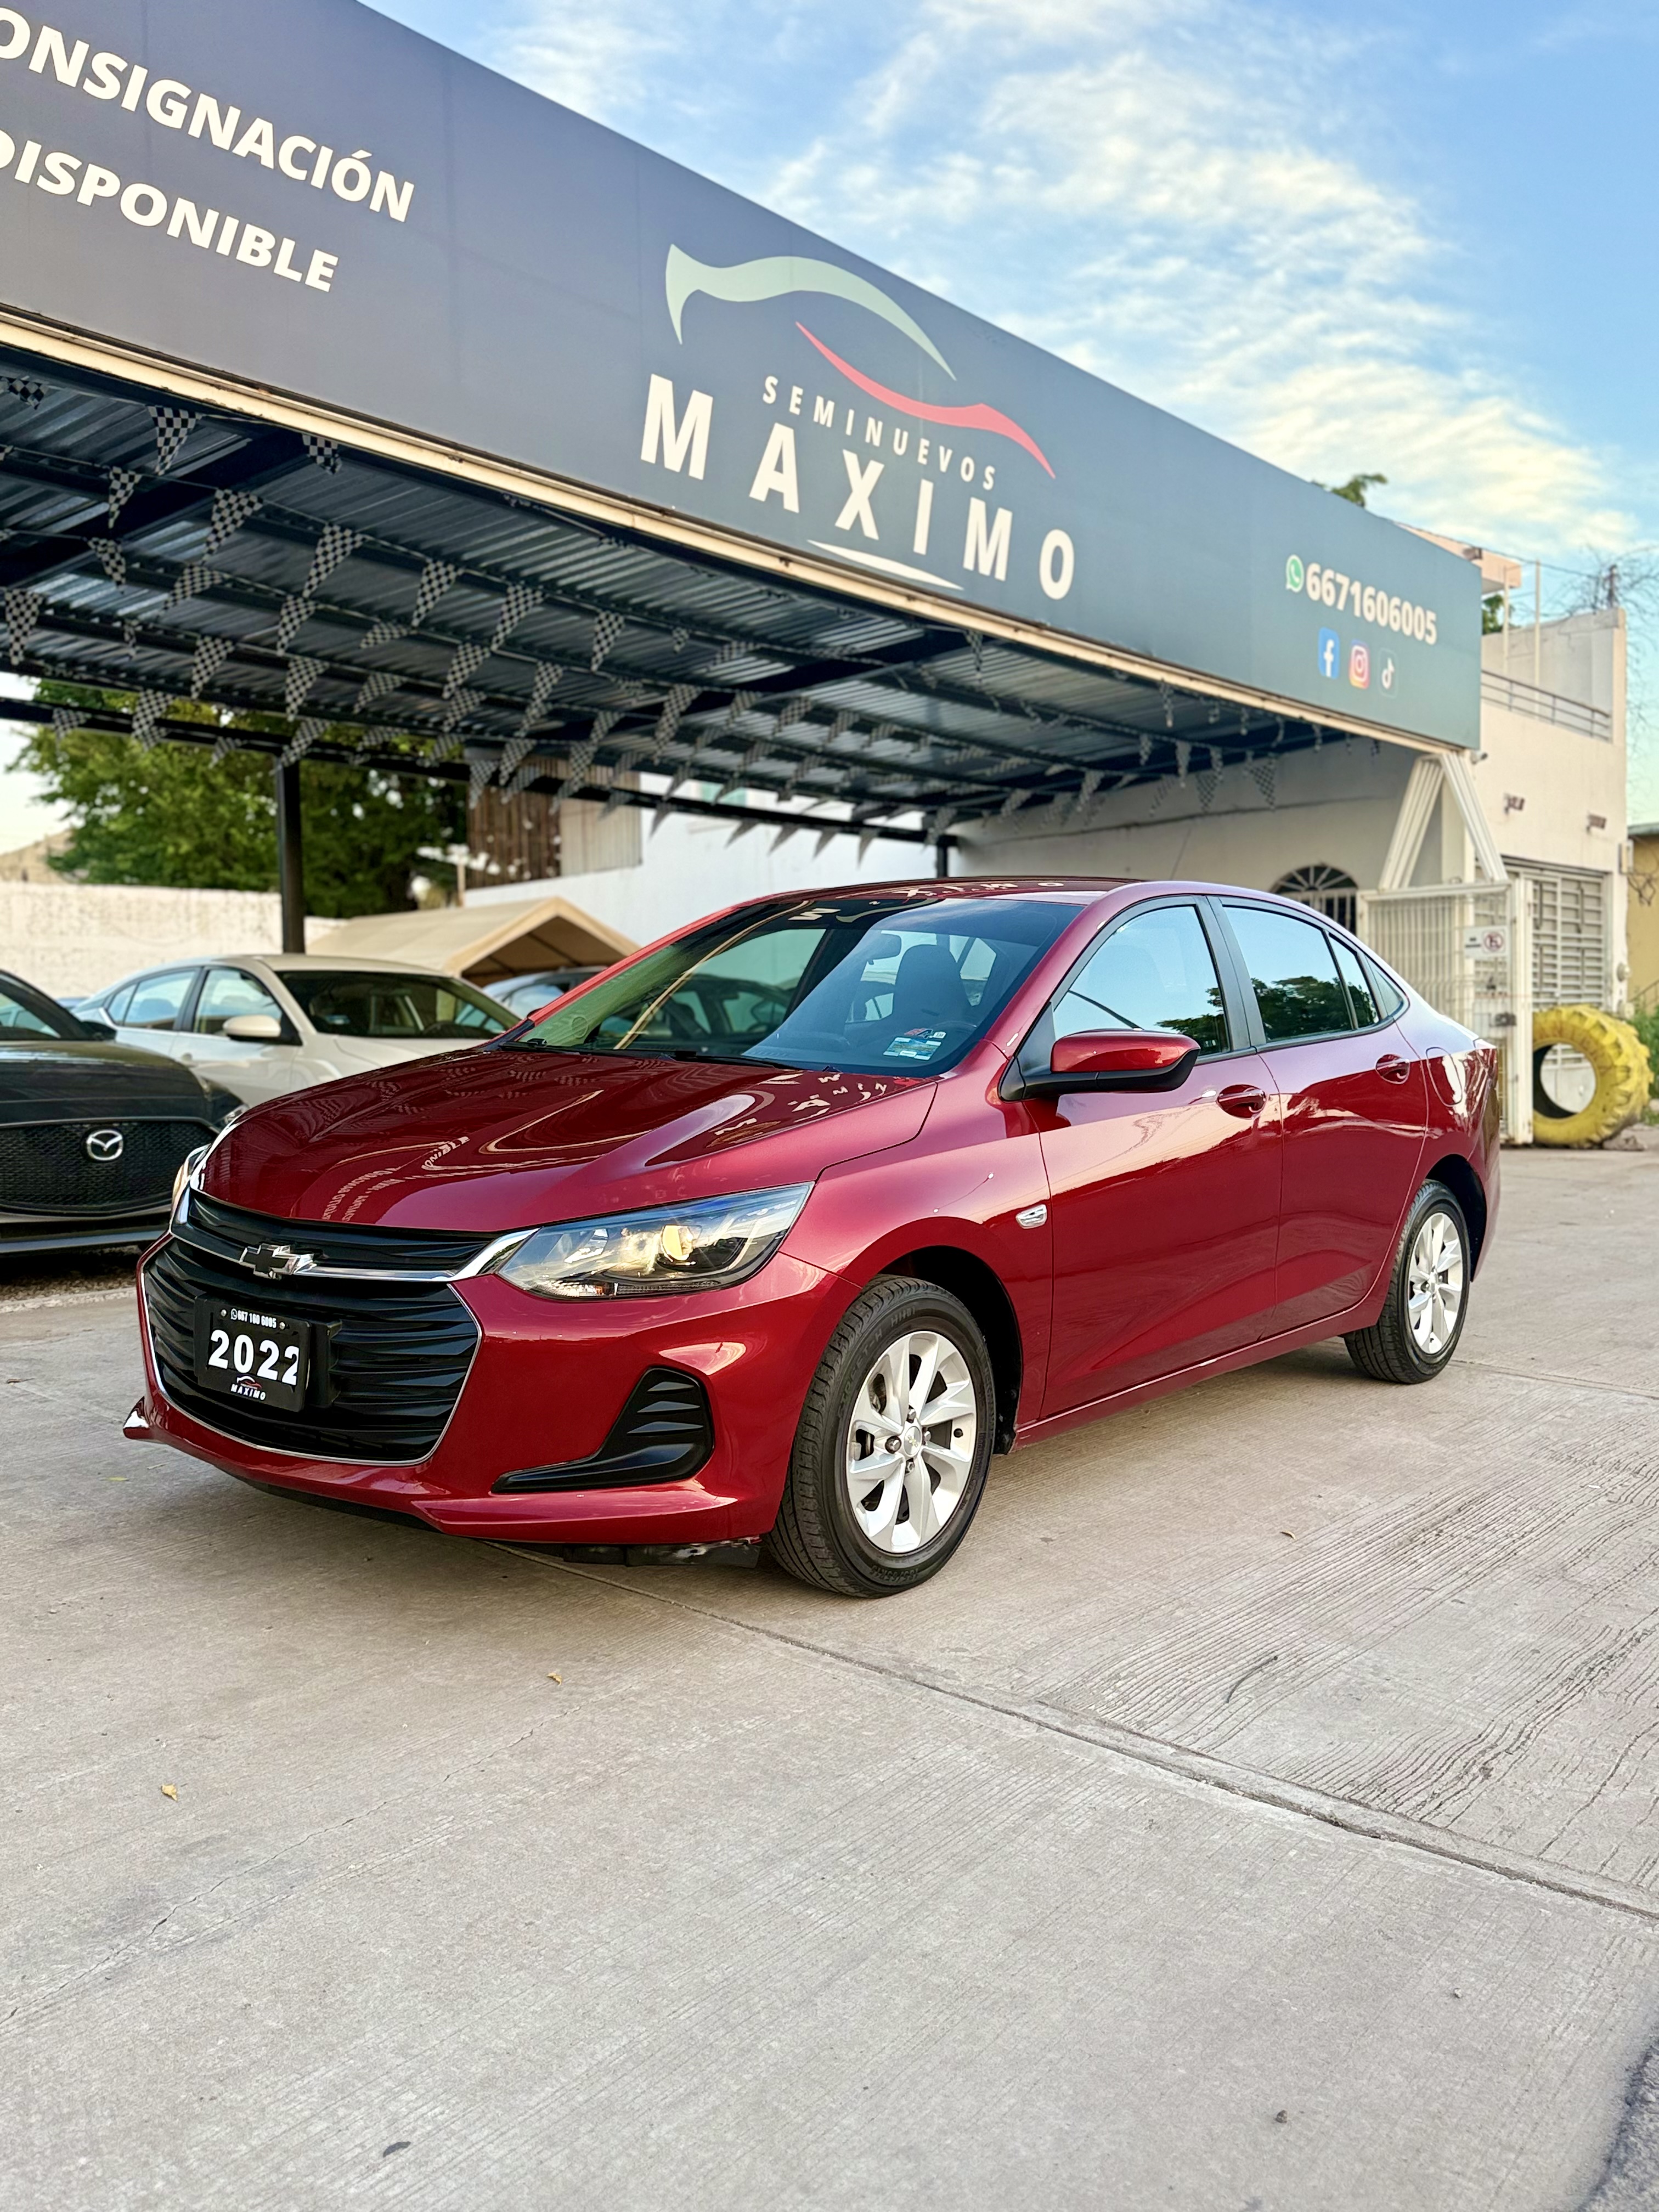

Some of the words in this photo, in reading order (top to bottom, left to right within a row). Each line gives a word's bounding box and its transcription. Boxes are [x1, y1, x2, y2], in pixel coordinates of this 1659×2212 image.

[763, 375, 996, 491] SEMINUEVOS
[640, 374, 1074, 600] MAXIMO
[1306, 563, 1437, 645] 6671606005
[208, 1329, 300, 1386] 2022
[230, 1384, 266, 1401] MAXIMO
